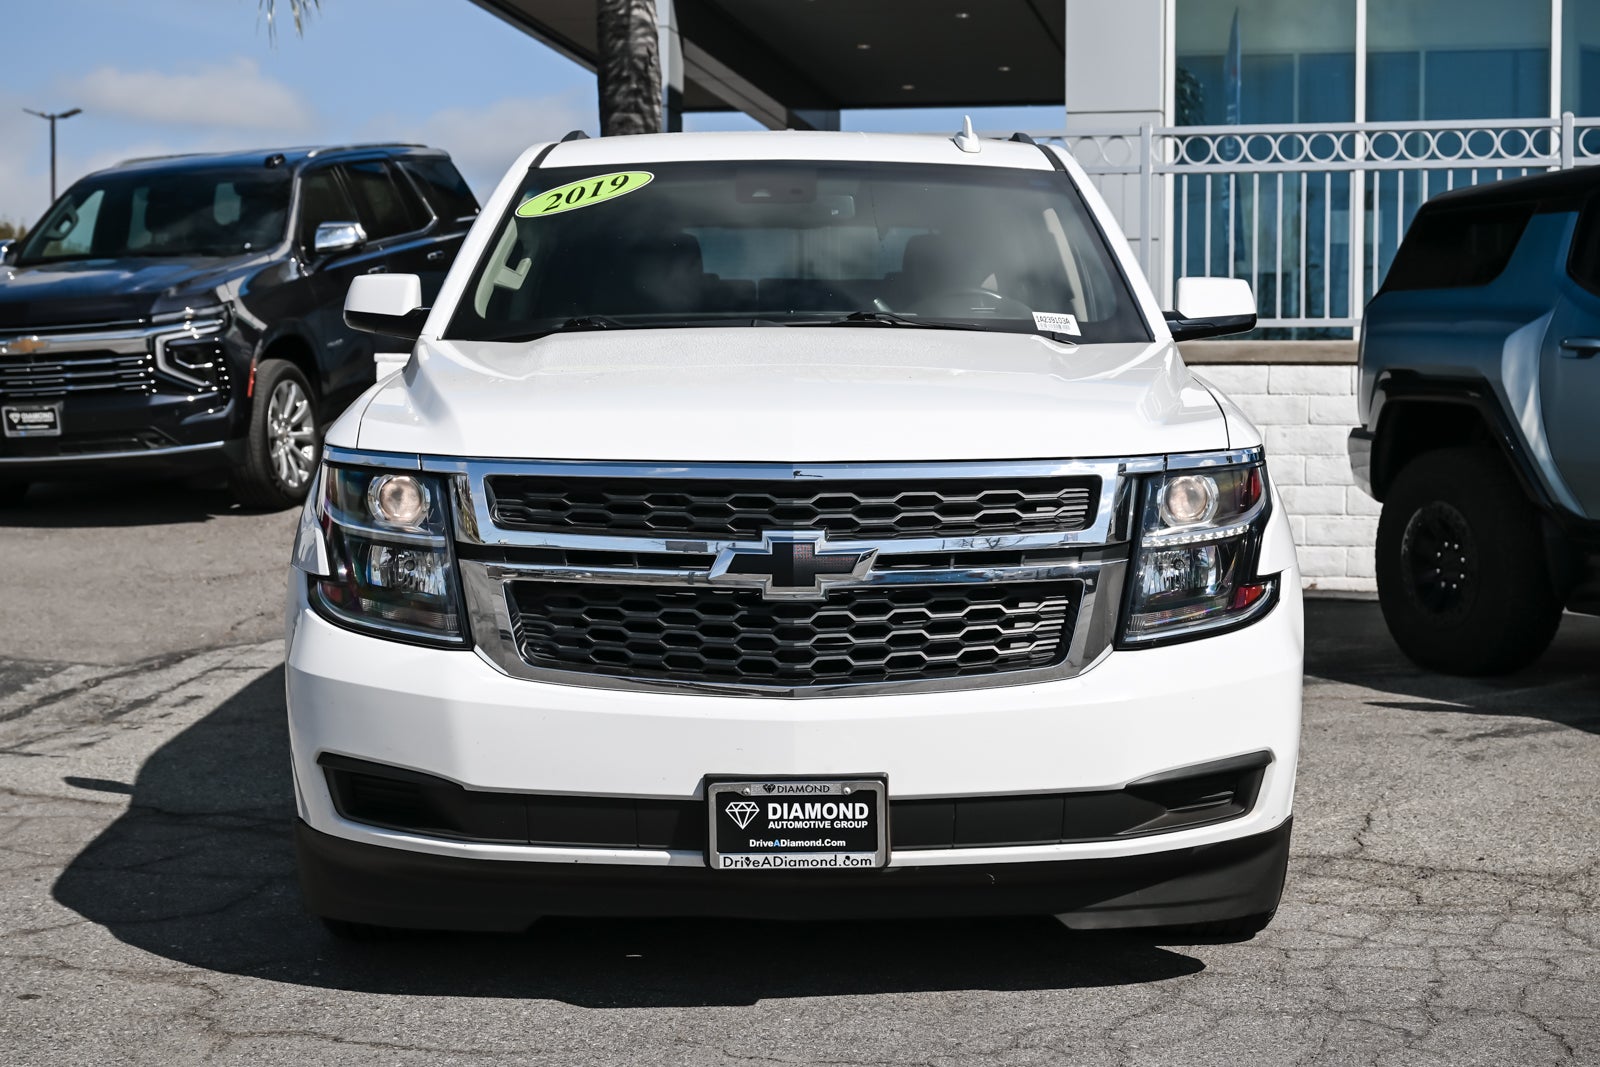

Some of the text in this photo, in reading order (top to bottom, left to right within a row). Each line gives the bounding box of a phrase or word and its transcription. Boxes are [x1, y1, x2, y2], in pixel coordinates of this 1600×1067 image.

[541, 174, 630, 213] 2019
[777, 784, 830, 793] DIAMOND
[767, 802, 869, 820] DIAMOND
[768, 820, 869, 829] AUTOMOTIVE GROUP
[749, 838, 846, 848] DriveADiamond.Com
